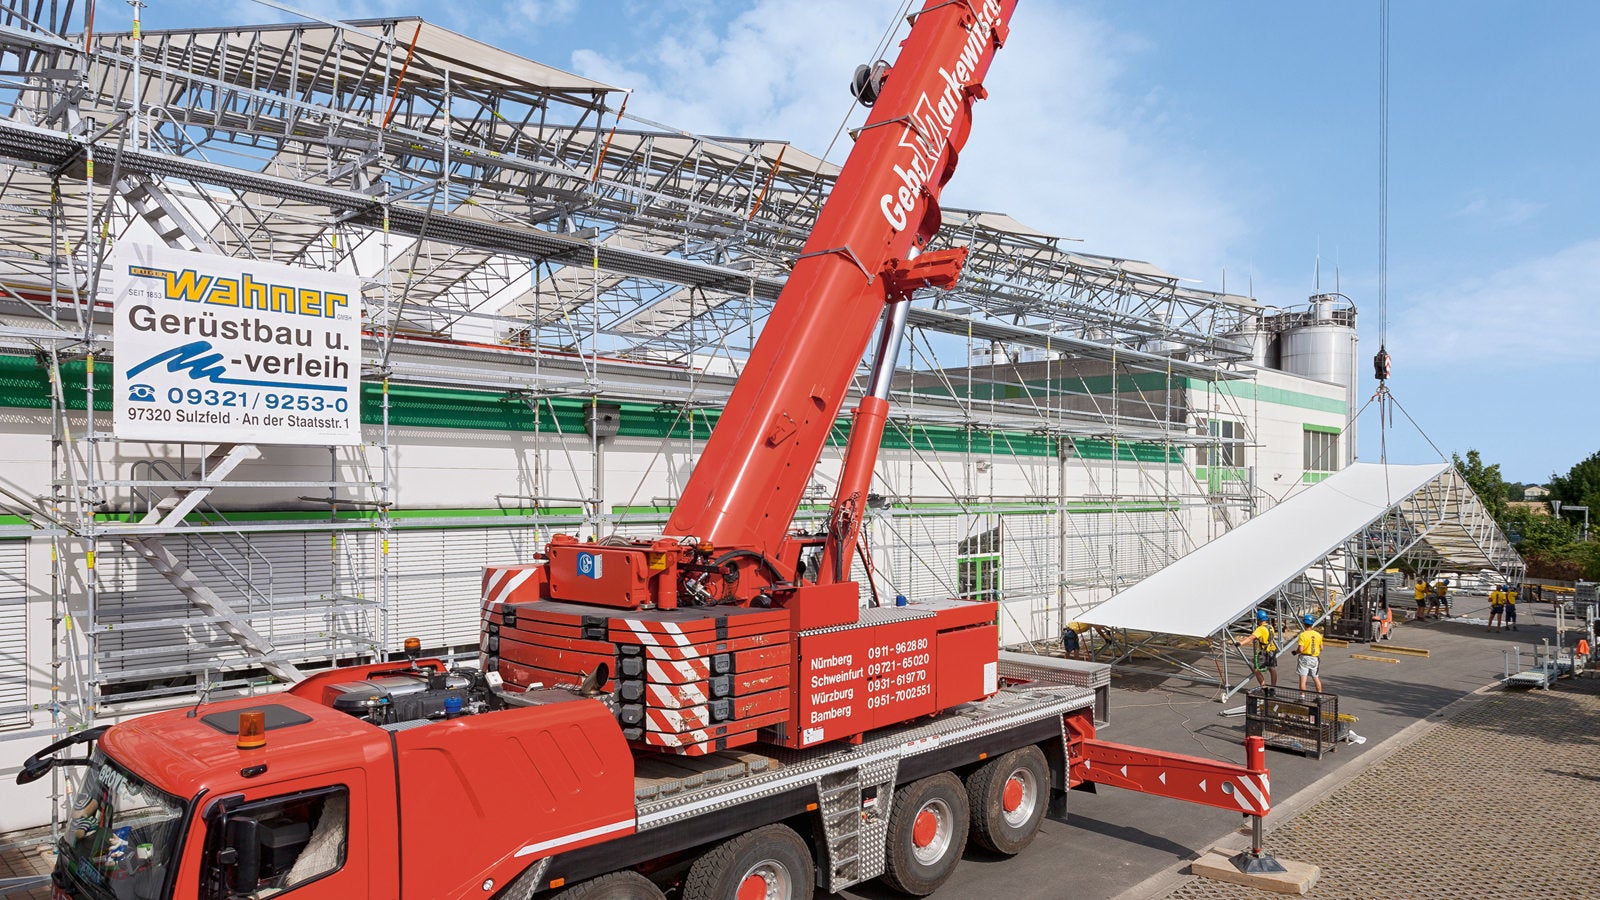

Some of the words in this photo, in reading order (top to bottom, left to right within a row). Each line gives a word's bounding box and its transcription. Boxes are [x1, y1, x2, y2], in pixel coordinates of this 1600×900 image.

[128, 288, 145, 297] SEIT
[146, 291, 163, 299] 1853
[165, 268, 349, 319] Wahner
[128, 304, 312, 347] Gerüstbau
[325, 331, 349, 350] u.
[231, 353, 349, 379] -verleih
[128, 407, 171, 422] 97320
[176, 409, 231, 425] Sulzfeld
[242, 413, 258, 426] An
[263, 414, 284, 427] der
[811, 653, 853, 671] Nürnberg
[811, 667, 864, 689] Schweinfurt
[811, 687, 854, 706] Würzburg
[810, 705, 852, 724] Bamberg
